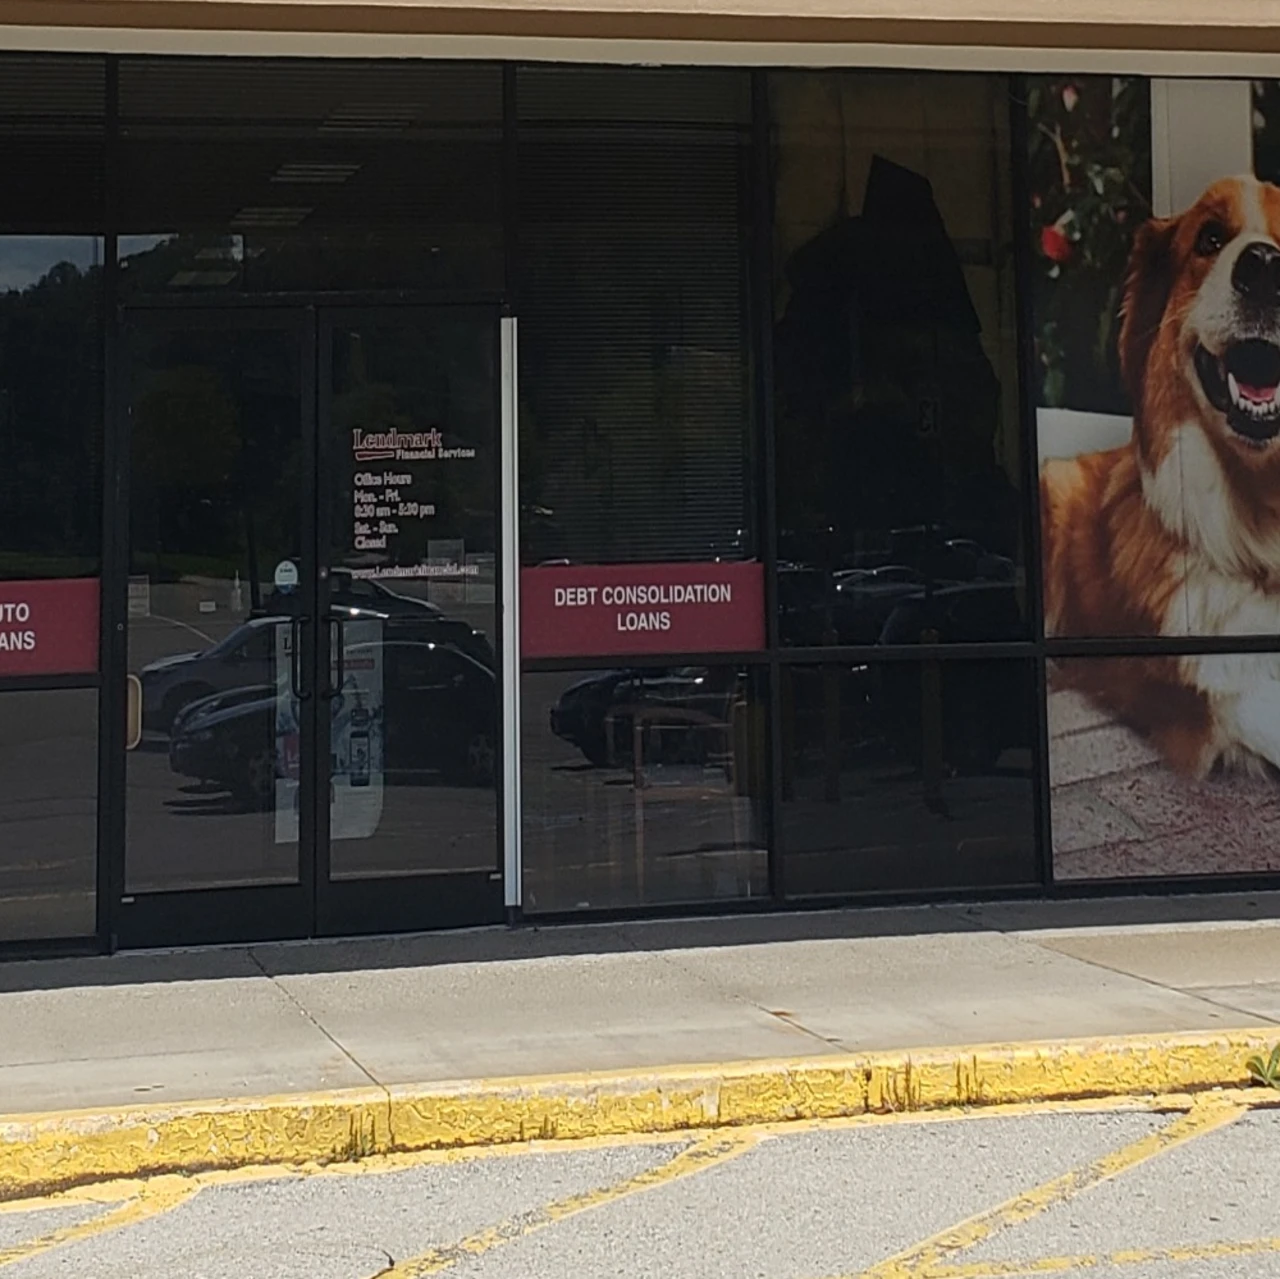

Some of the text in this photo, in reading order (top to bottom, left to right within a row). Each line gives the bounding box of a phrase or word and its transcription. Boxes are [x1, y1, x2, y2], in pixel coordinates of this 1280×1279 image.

[353, 427, 443, 450] Lendmark
[395, 447, 476, 460] Financial Services
[354, 472, 412, 486] Office Hours
[420, 505, 435, 519] pm
[354, 535, 387, 549] Closed
[555, 584, 731, 606] DEBT CONSOLIDATION
[617, 611, 671, 631] LOANS
